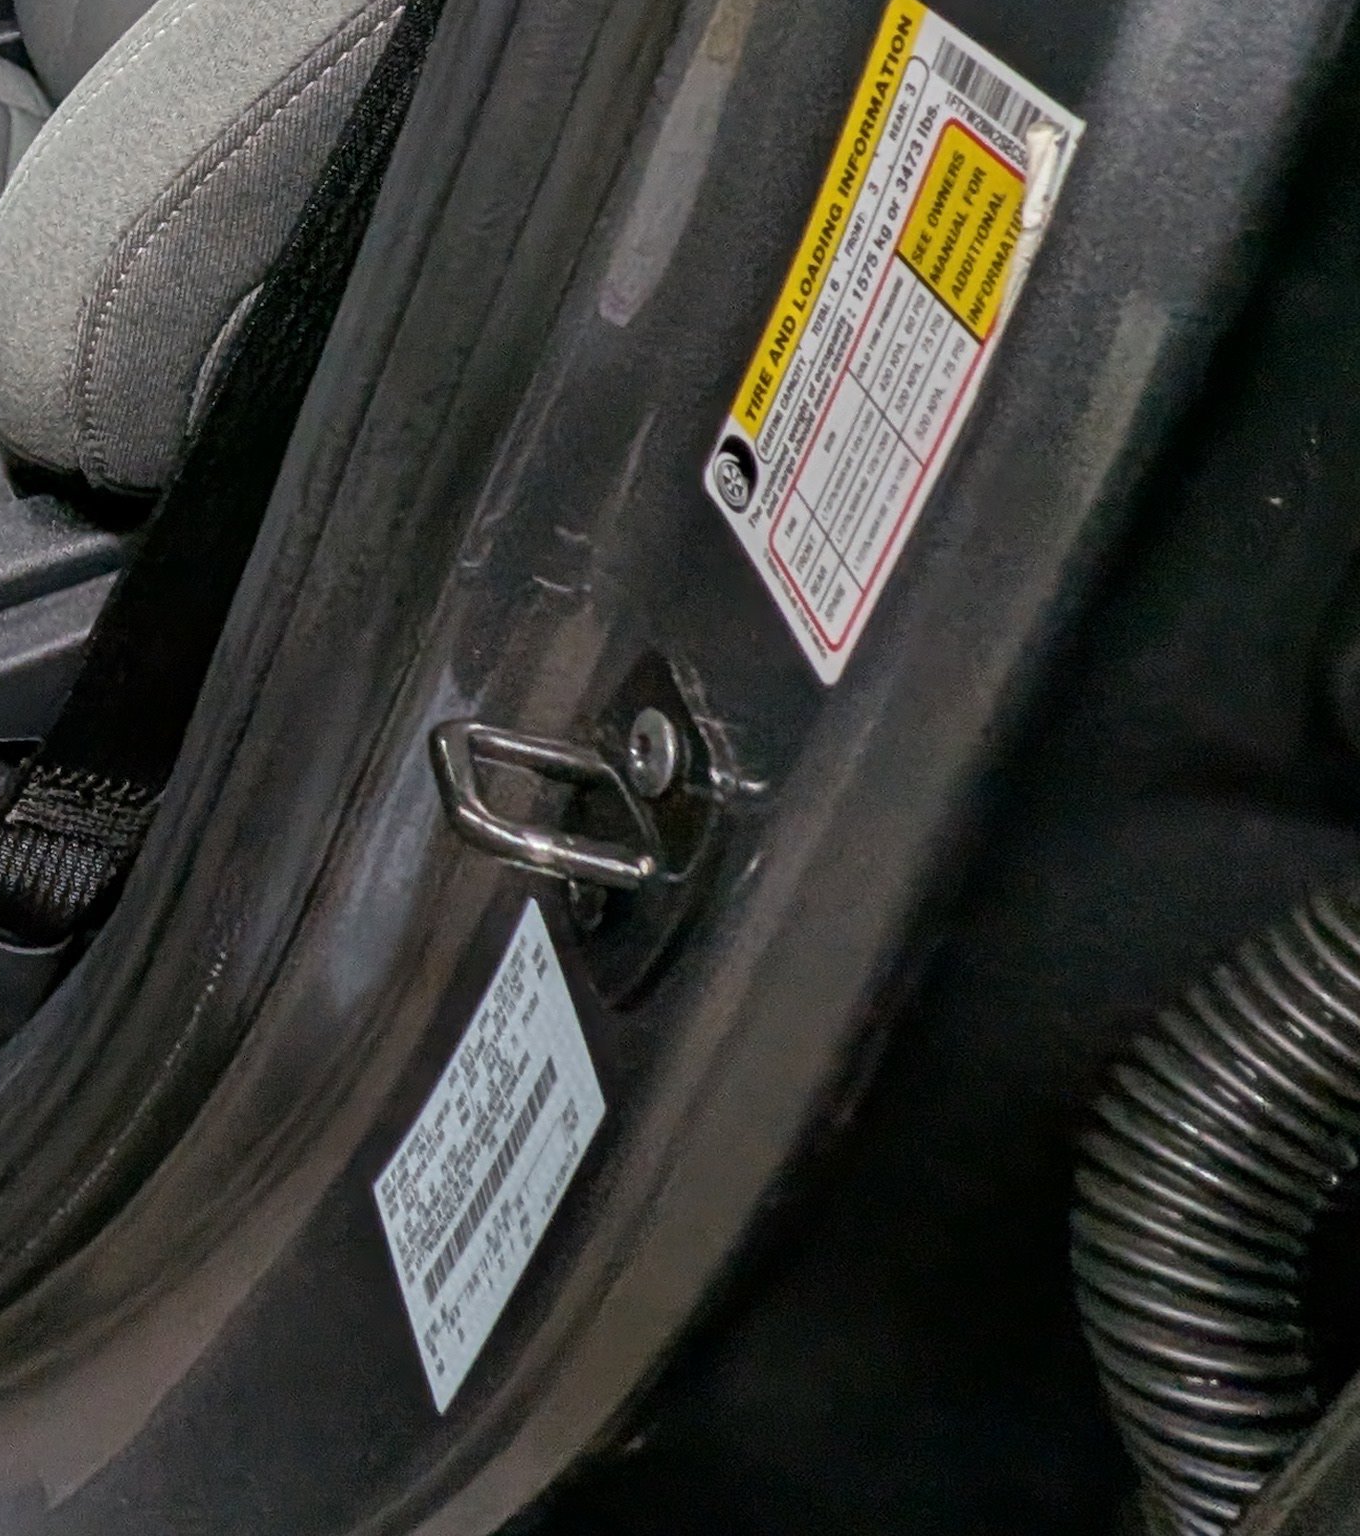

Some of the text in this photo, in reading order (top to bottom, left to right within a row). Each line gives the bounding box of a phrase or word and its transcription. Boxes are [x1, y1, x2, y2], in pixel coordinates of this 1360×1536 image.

[904, 82, 916, 96] 3
[744, 14, 912, 421] TIRE AND LOADING INFORMATION
[852, 250, 878, 301] 1575
[873, 224, 892, 250] kg
[887, 199, 900, 221] or
[896, 139, 923, 194] 3473
[916, 104, 940, 138] lbs.
[868, 181, 879, 195] 3
[911, 152, 965, 265] SEE OWNERS
[929, 166, 987, 285] MANUAL FOR
[951, 192, 1006, 300] ADDITIONAL
[966, 200, 1027, 326] INFORMATIO
